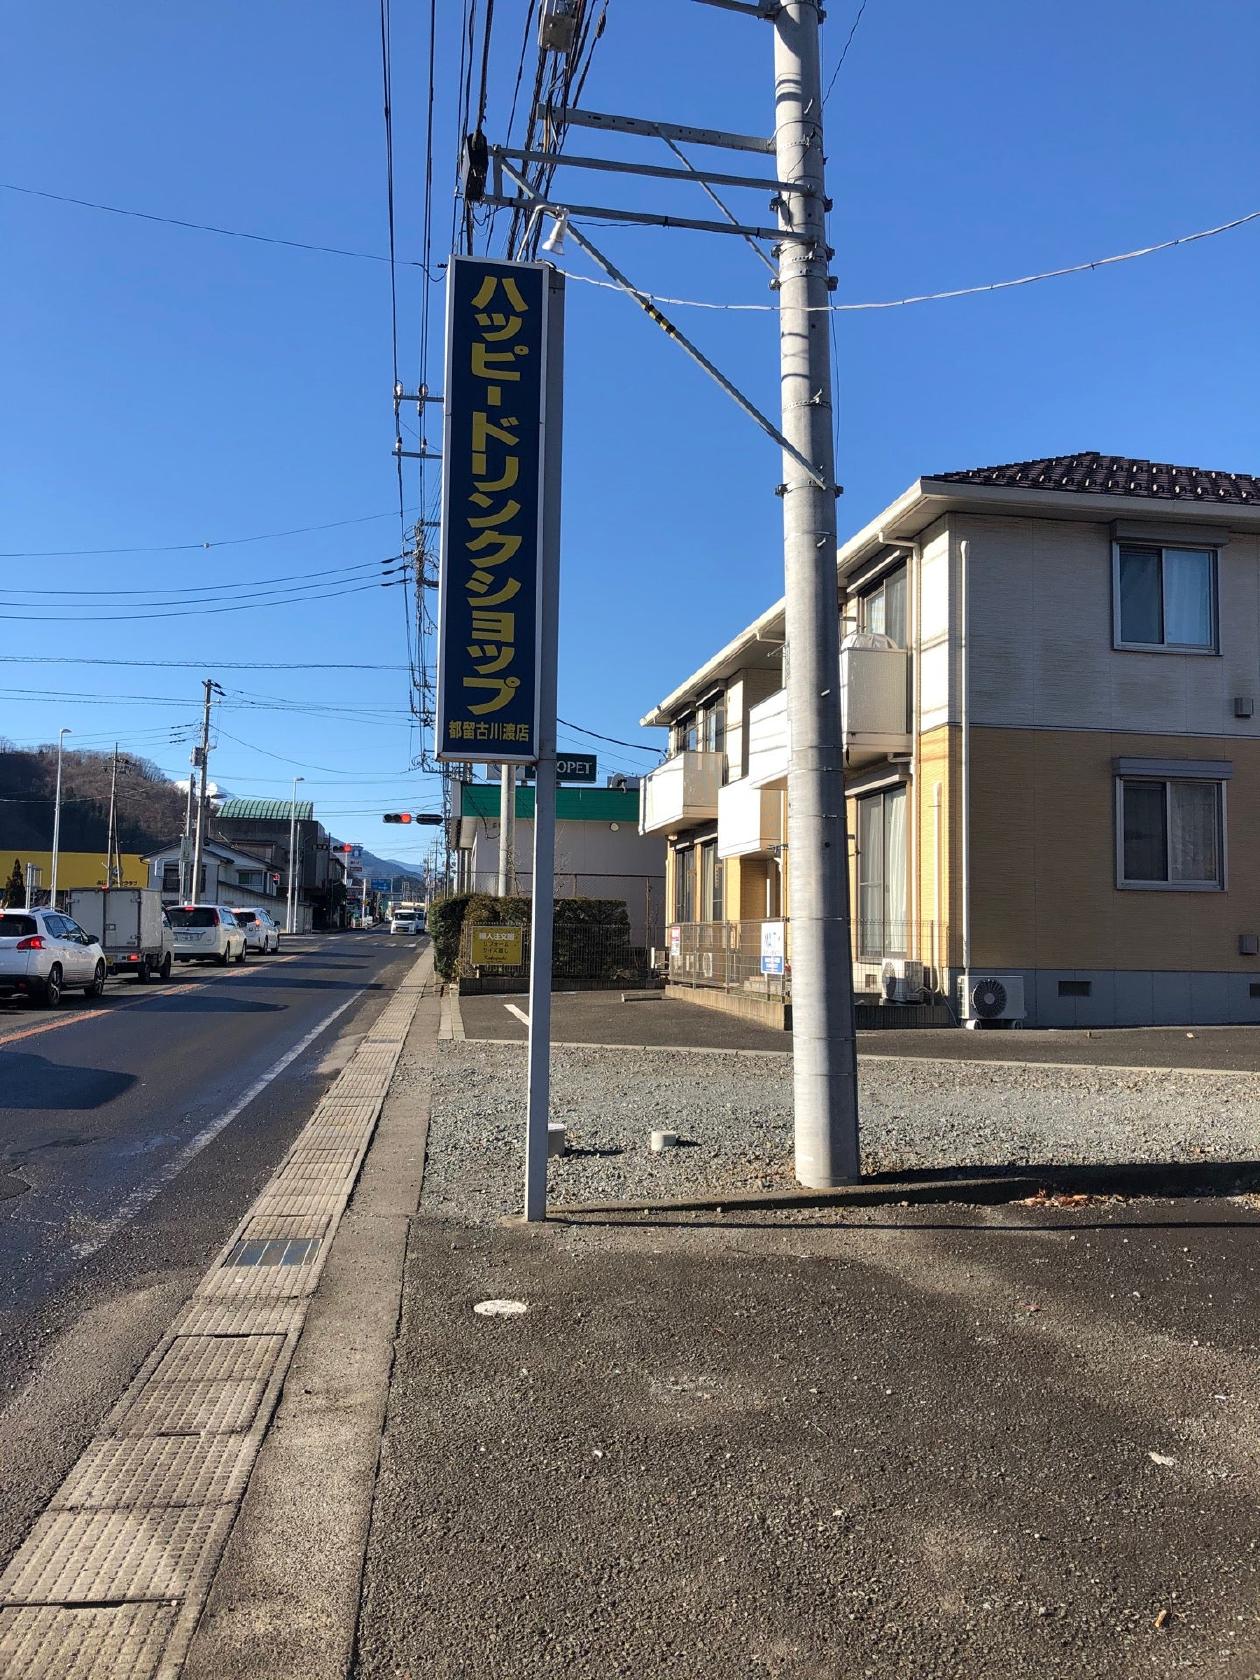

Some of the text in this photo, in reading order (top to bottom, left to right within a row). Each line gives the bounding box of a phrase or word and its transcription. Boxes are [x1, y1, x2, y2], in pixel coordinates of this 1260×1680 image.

[463, 276, 529, 715] ハッピードリンクショップ
[449, 720, 530, 742] 都留古川渡店
